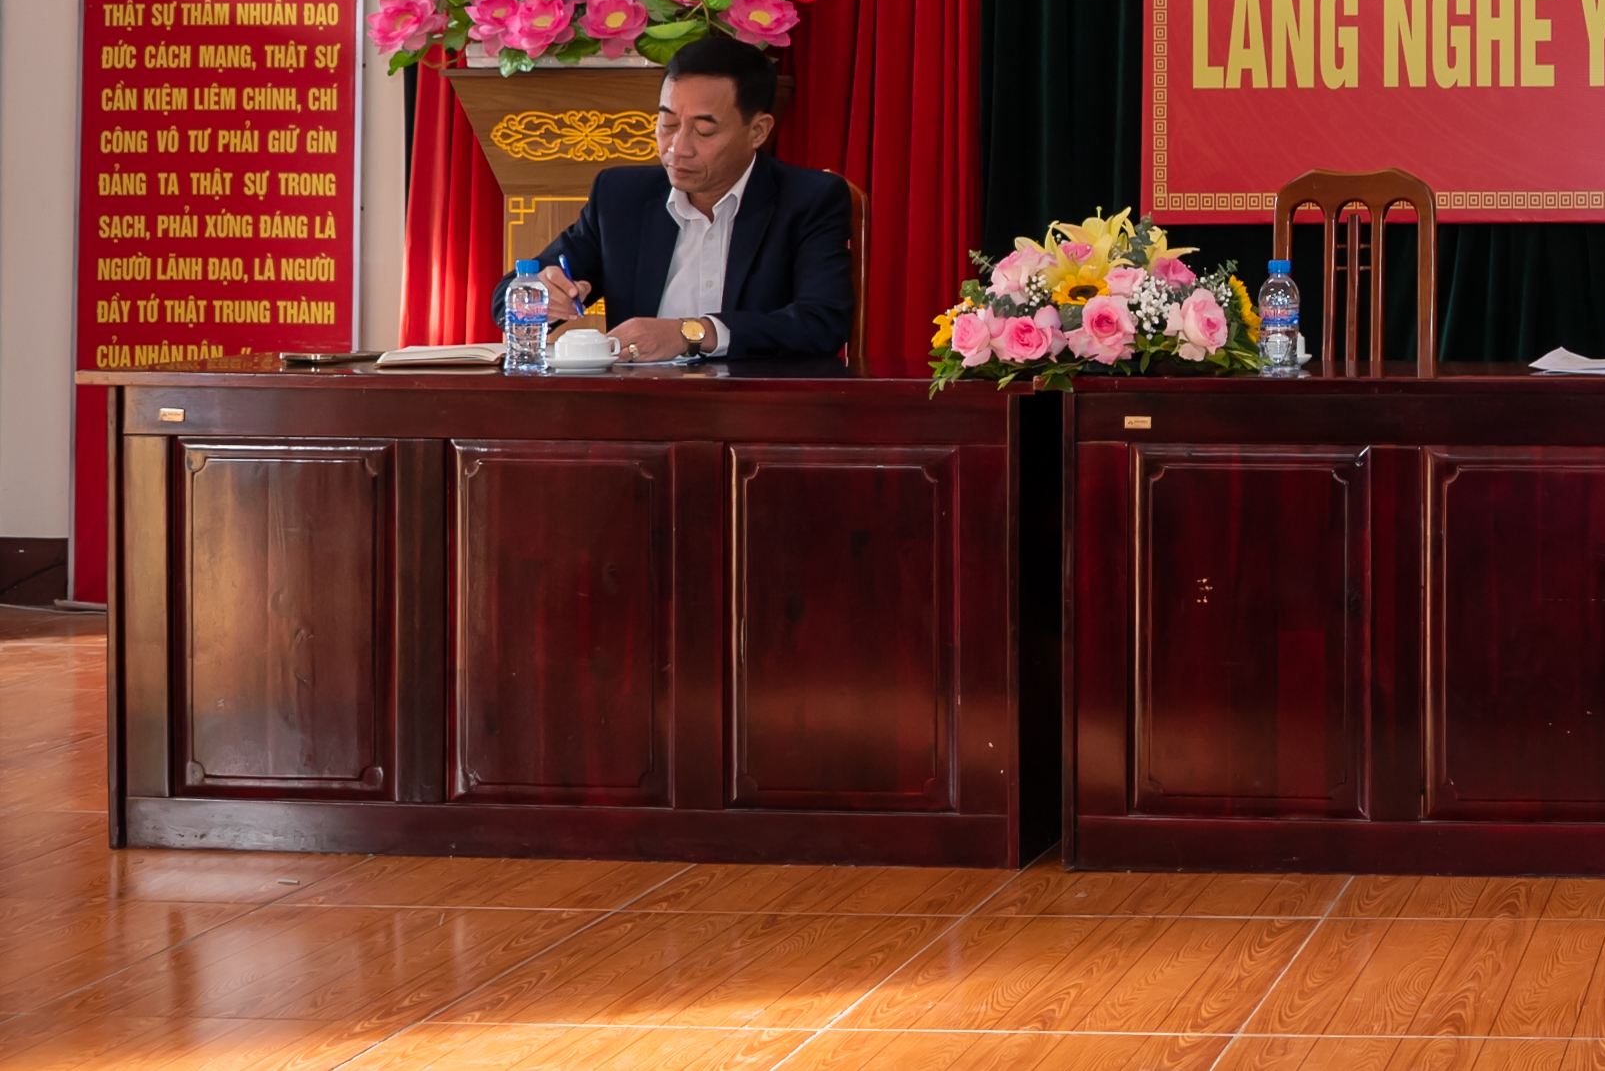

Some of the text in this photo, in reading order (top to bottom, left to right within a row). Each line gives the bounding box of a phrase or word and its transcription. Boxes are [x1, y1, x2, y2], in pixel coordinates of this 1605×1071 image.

[101, 40, 341, 73] ĐỨC CÁCH MẠNG, THẬT SỰ
[100, 120, 337, 154] CÔNG VÔ TƯ PHẢI GIỮ GÌN
[99, 205, 337, 243] SẠCH, PHẢI XỨNG ĐÁNG LÀ
[96, 294, 335, 328] ĐẦY TỚ THẬT TRUNG THÀNH
[96, 335, 131, 368] CỦA
[134, 340, 184, 366] NHÂN
